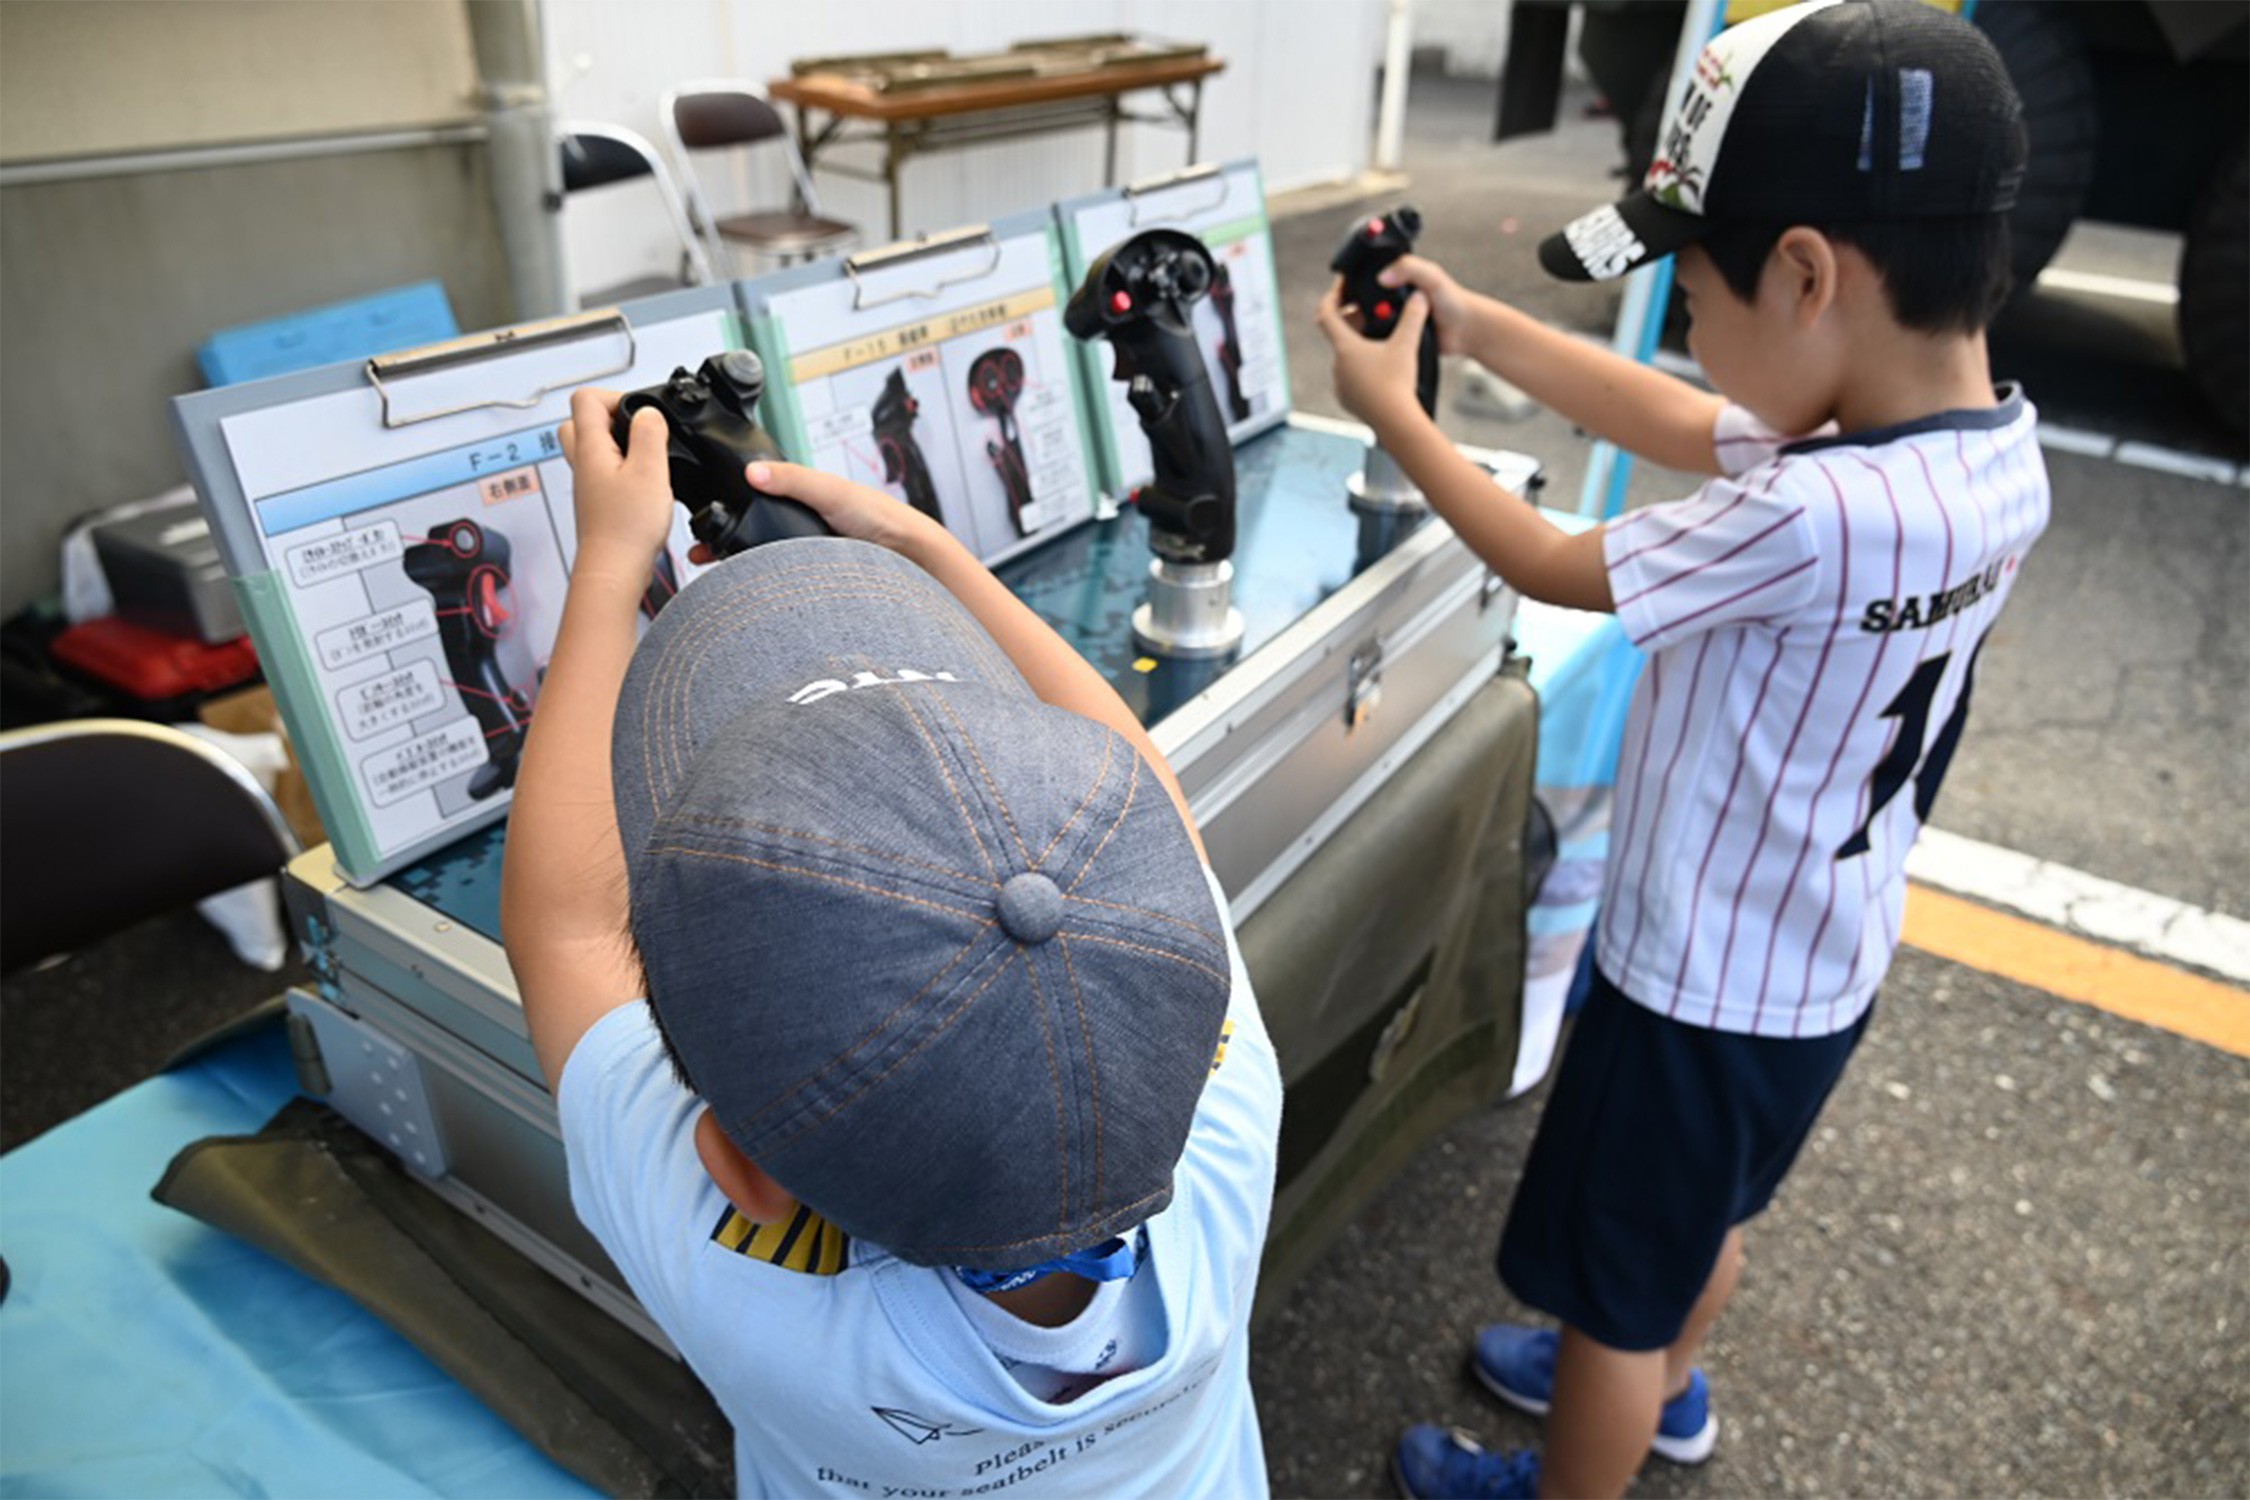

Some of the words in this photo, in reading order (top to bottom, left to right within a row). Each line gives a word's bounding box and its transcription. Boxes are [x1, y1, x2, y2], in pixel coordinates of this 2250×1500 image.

[817, 1467, 870, 1490] that
[882, 1485, 951, 1500] your
[961, 1447, 1066, 1496] seatbelt
[1076, 1433, 1096, 1453] is
[974, 1439, 1045, 1476] Pleas
